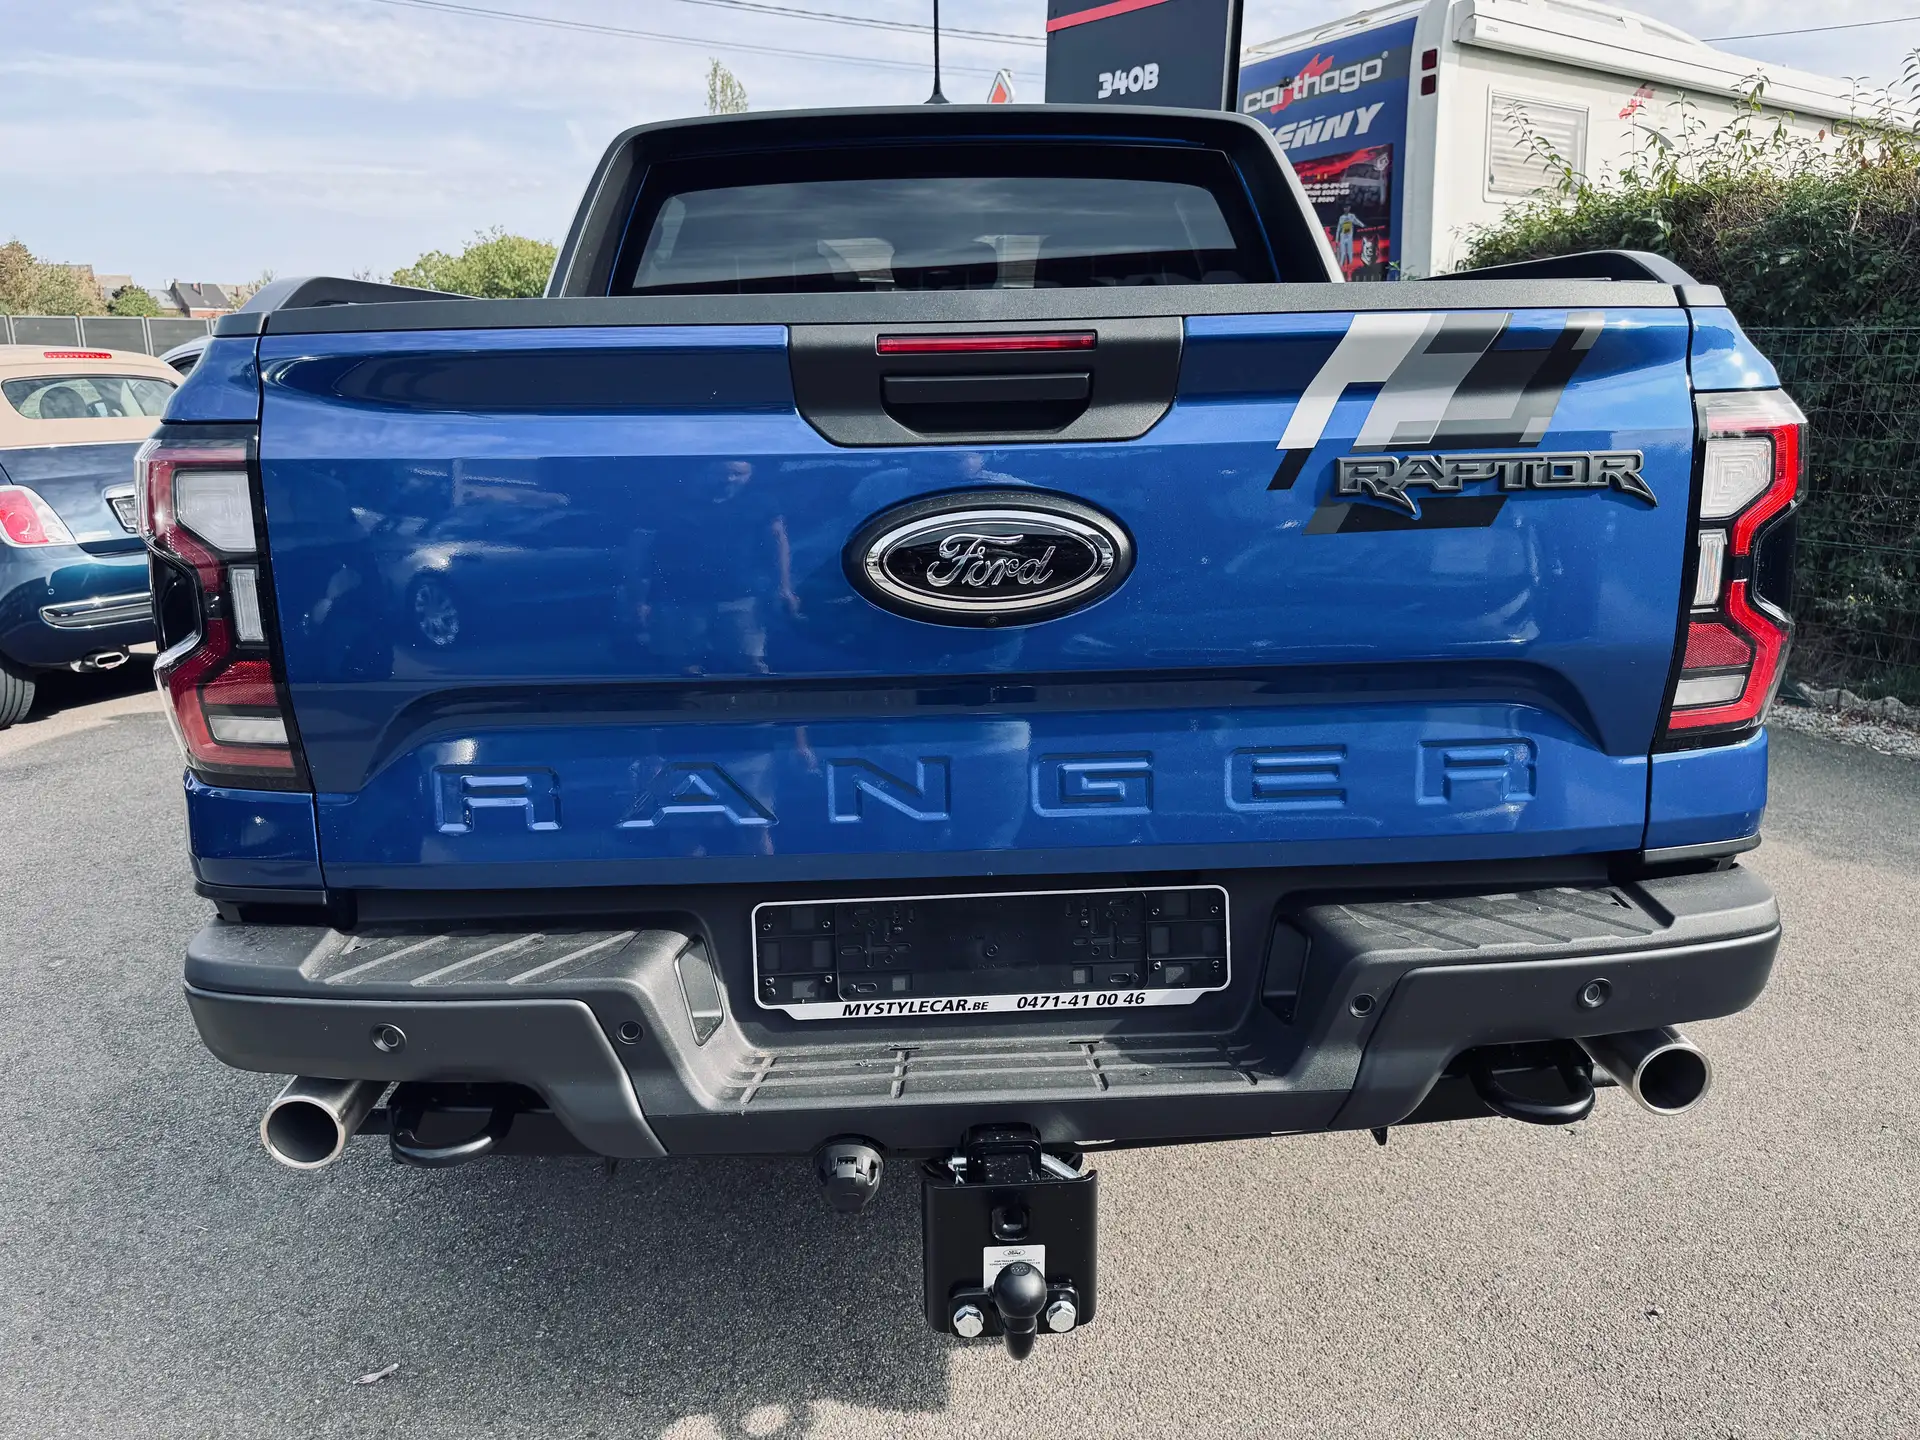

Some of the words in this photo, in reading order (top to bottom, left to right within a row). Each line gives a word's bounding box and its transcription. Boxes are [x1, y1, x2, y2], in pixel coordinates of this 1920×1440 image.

[1098, 62, 1159, 99] 340B
[1243, 57, 1384, 114] carthago
[1268, 101, 1386, 152] ENNY
[1335, 449, 1659, 516] RAPTOR
[925, 532, 1057, 588] Ford
[432, 736, 1540, 836] RANGER
[1016, 993, 1090, 1009] 0471-41
[1095, 993, 1119, 1006] 00
[1122, 992, 1146, 1005] 46
